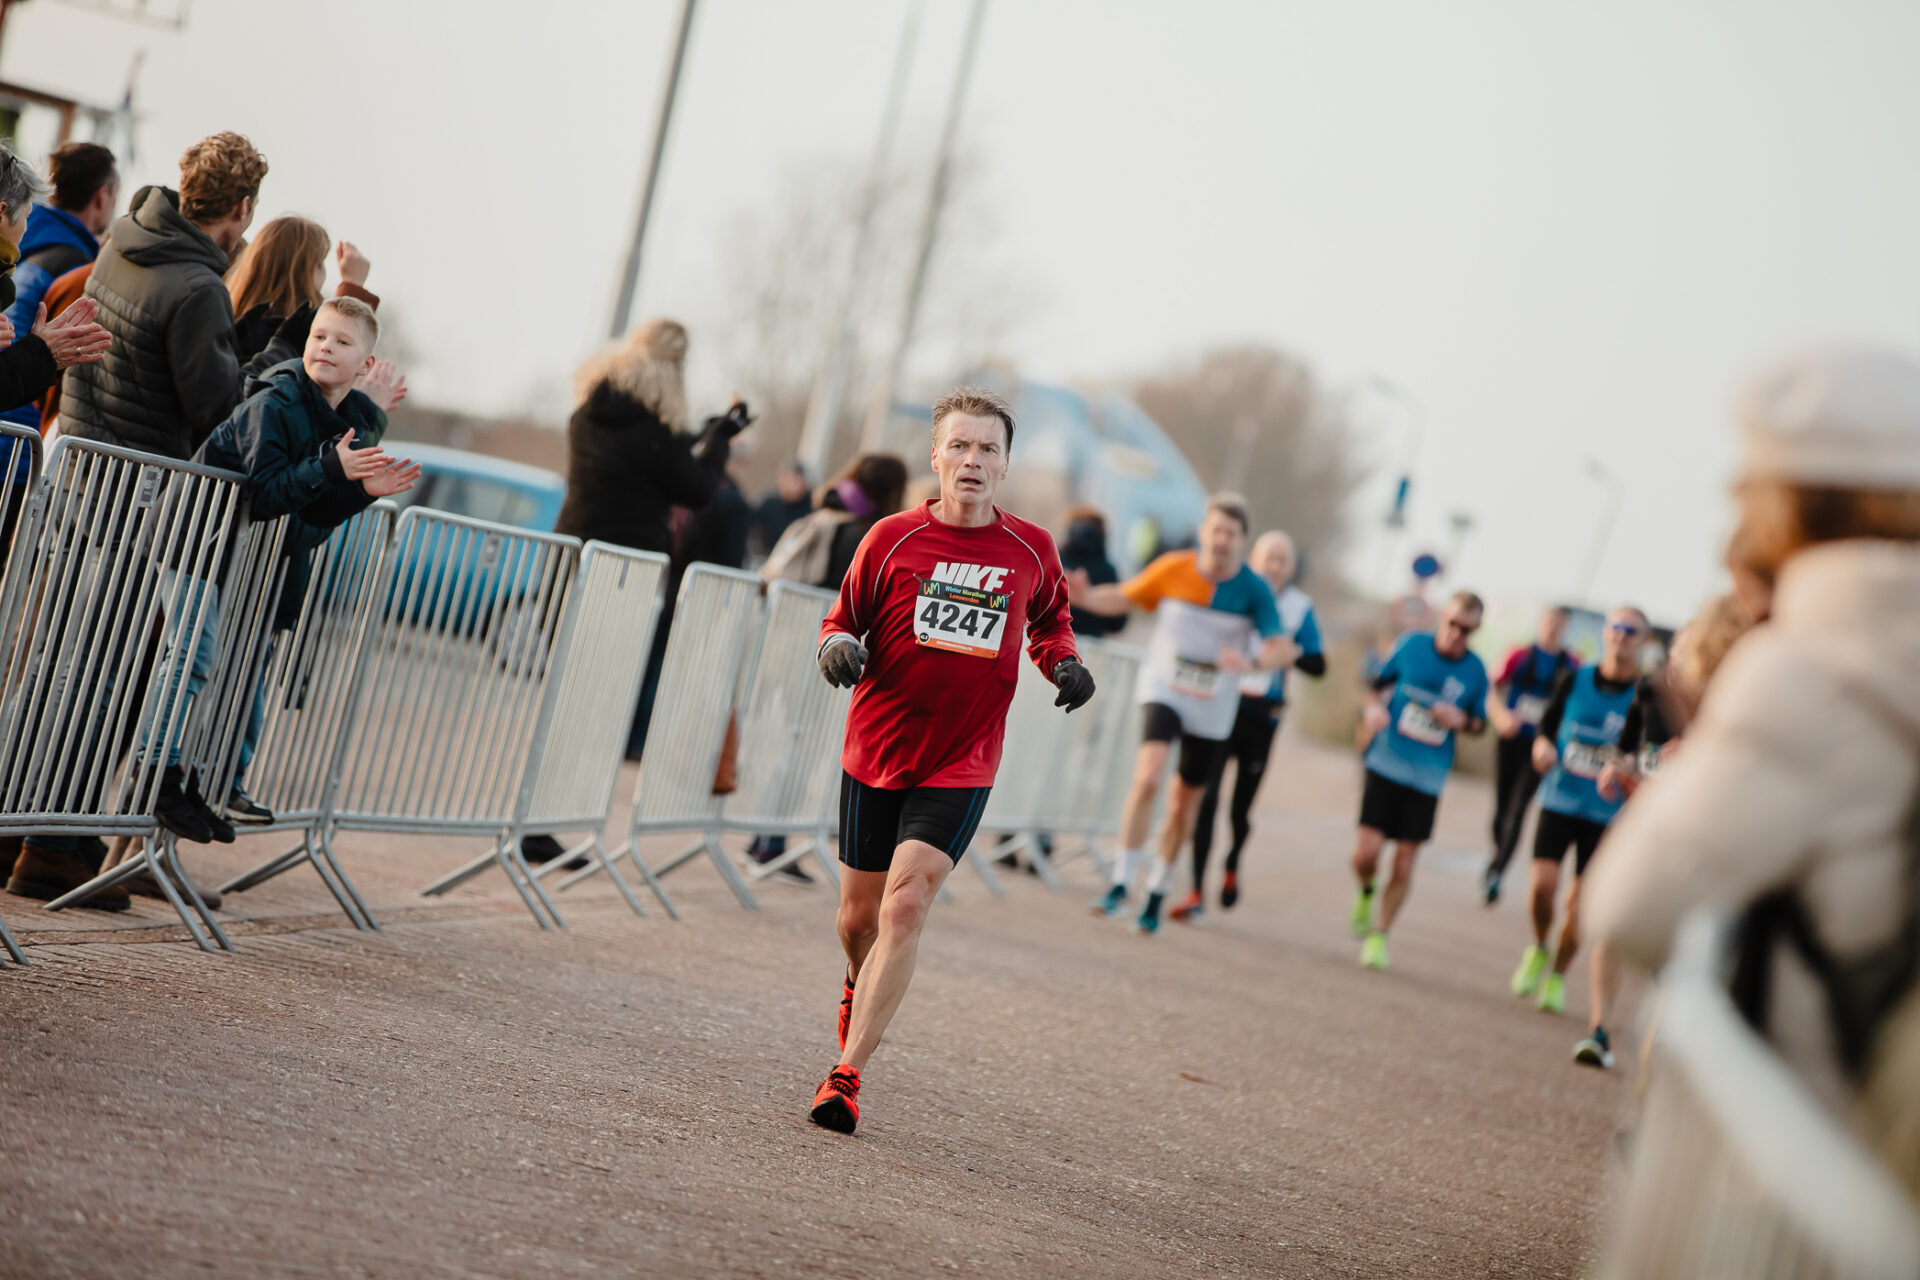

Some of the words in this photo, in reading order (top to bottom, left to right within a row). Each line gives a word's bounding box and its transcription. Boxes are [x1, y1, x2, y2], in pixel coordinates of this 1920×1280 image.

[945, 585, 962, 595] Winter
[962, 588, 986, 600] Marathon
[920, 601, 1000, 640] 4247
